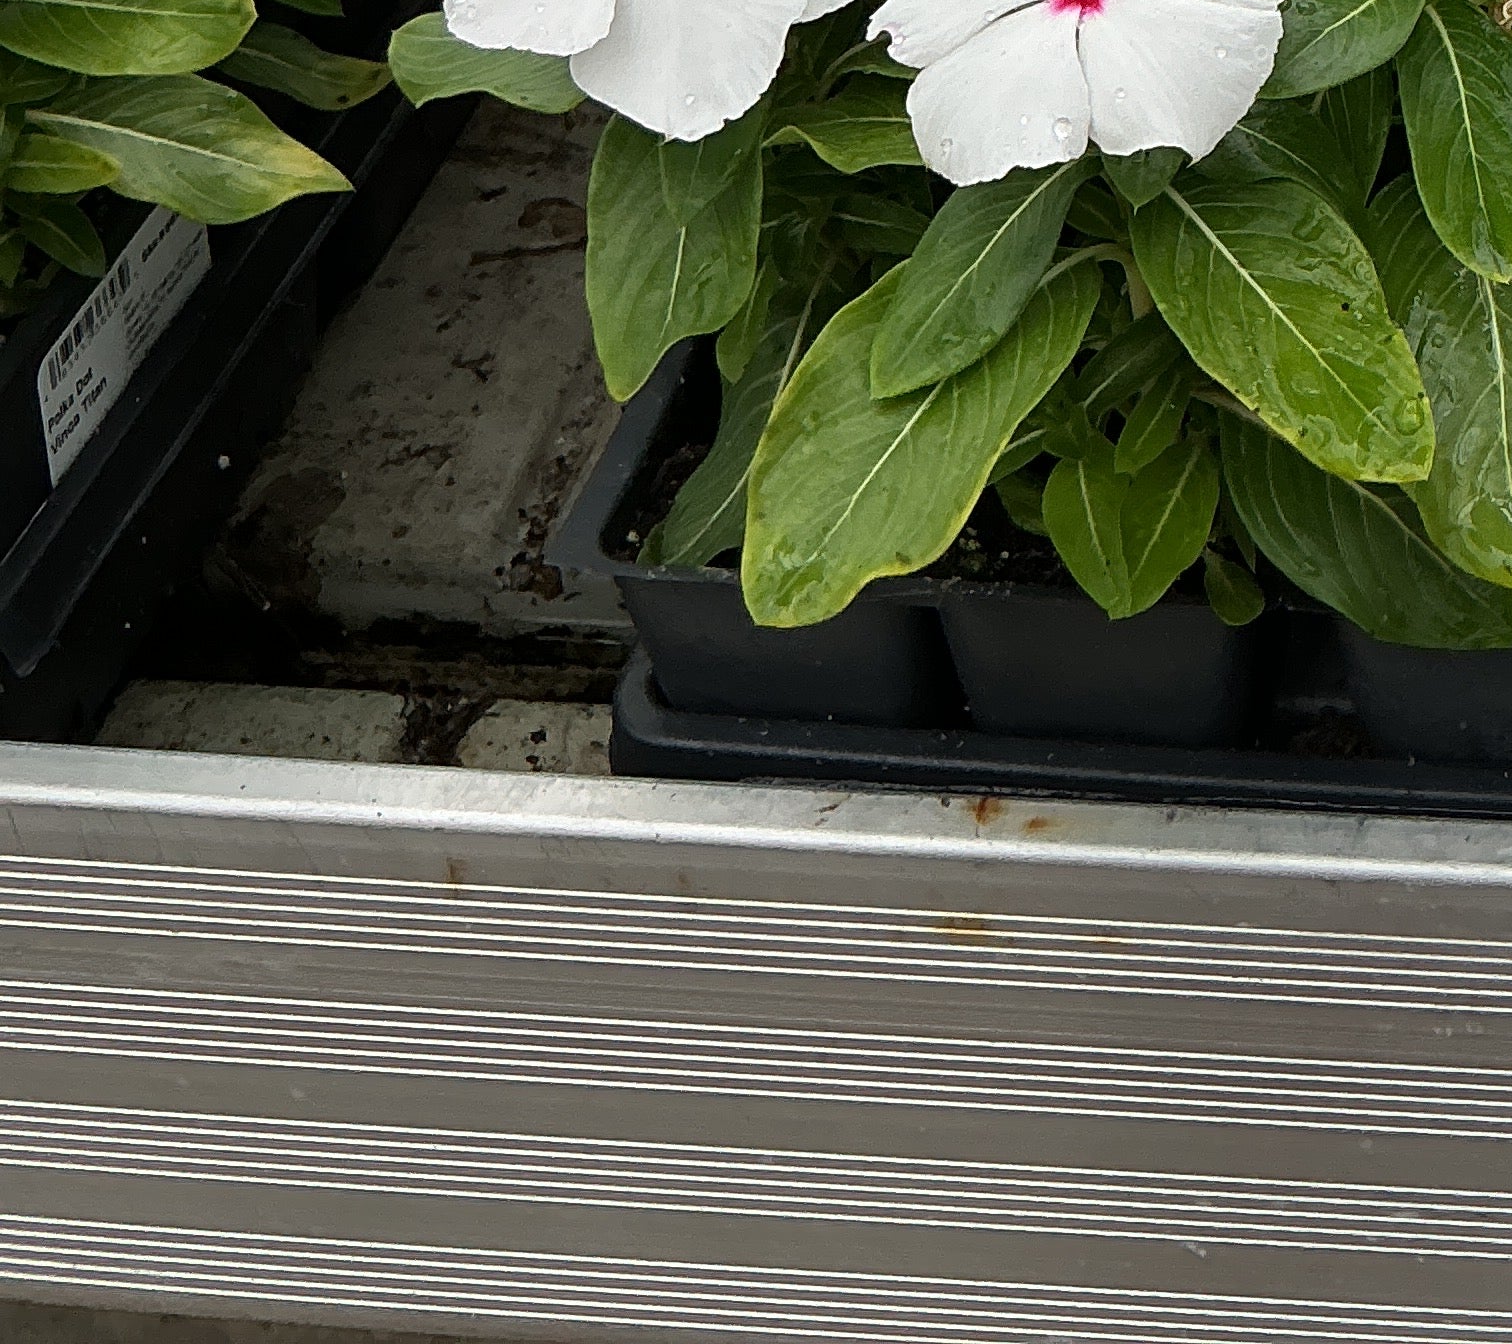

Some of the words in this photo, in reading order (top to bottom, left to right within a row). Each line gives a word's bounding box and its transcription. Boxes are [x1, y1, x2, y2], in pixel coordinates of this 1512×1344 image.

[47, 395, 75, 435] Polka
[75, 368, 95, 398] Dot
[81, 376, 108, 416] Titan
